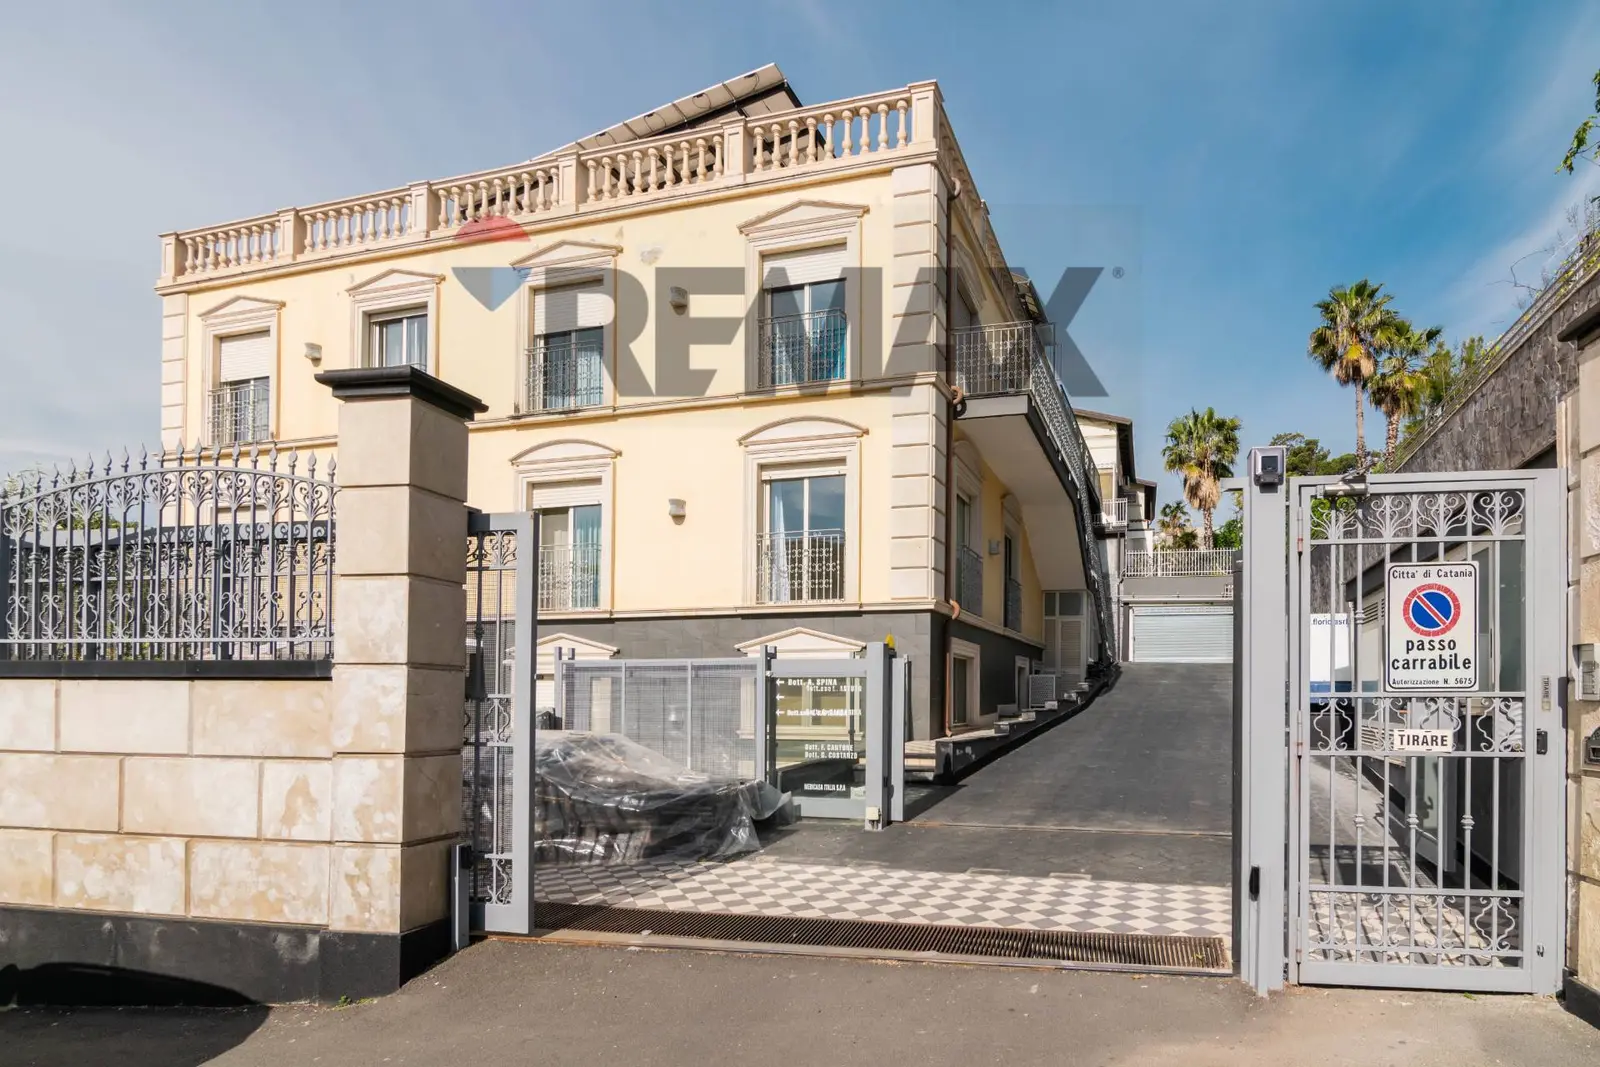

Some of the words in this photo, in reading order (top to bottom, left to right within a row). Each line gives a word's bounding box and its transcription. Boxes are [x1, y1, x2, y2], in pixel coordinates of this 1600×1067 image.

[1423, 569, 1431, 578] di
[1437, 569, 1473, 578] Catania
[1406, 639, 1456, 654] passo
[1391, 653, 1472, 670] carrabile
[817, 679, 838, 687] SPINA
[1454, 677, 1473, 685] 5675
[1398, 734, 1448, 747] TIRARE
[828, 752, 858, 760] COSTANZO
